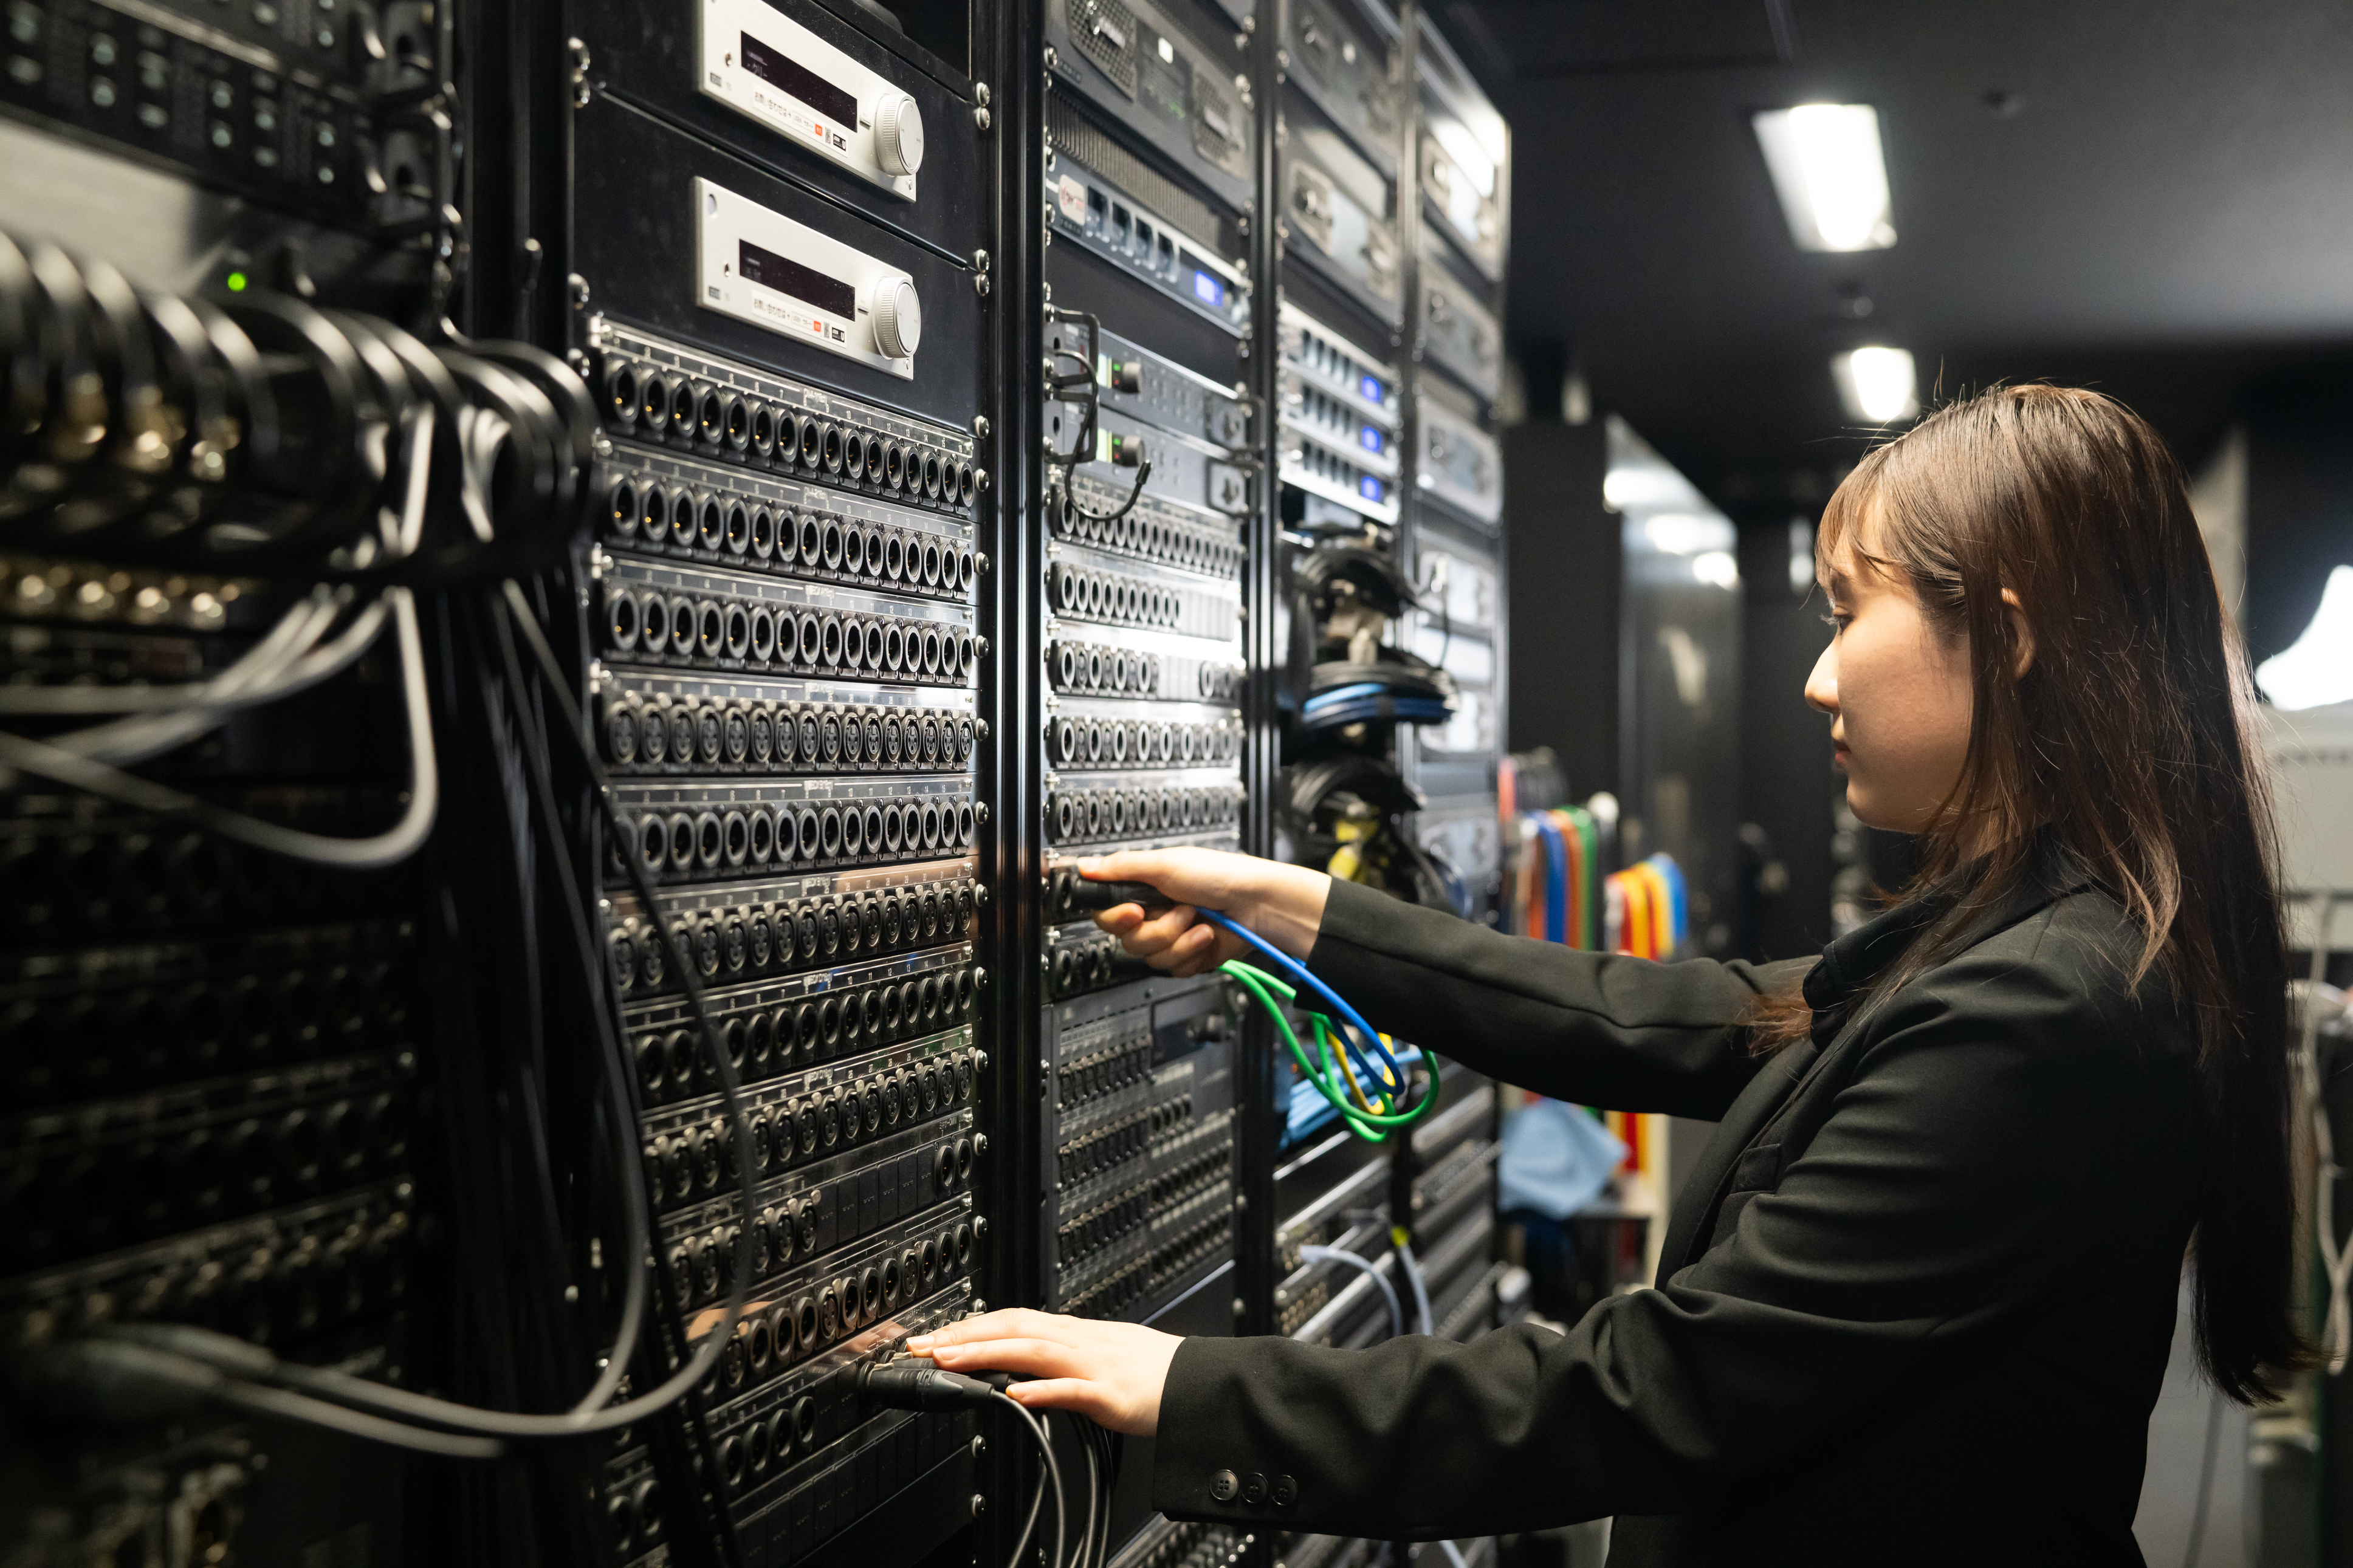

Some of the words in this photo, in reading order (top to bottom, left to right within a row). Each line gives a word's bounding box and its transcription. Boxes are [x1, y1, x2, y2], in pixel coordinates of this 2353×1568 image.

[847, 411, 851, 419] 10
[847, 505, 851, 513] 10
[848, 789, 853, 797] 10
[869, 787, 873, 796] 11
[888, 787, 893, 795] 12
[907, 786, 911, 795] 13
[866, 880, 870, 889] 27
[848, 976, 853, 985] 10
[888, 968, 892, 976] 12
